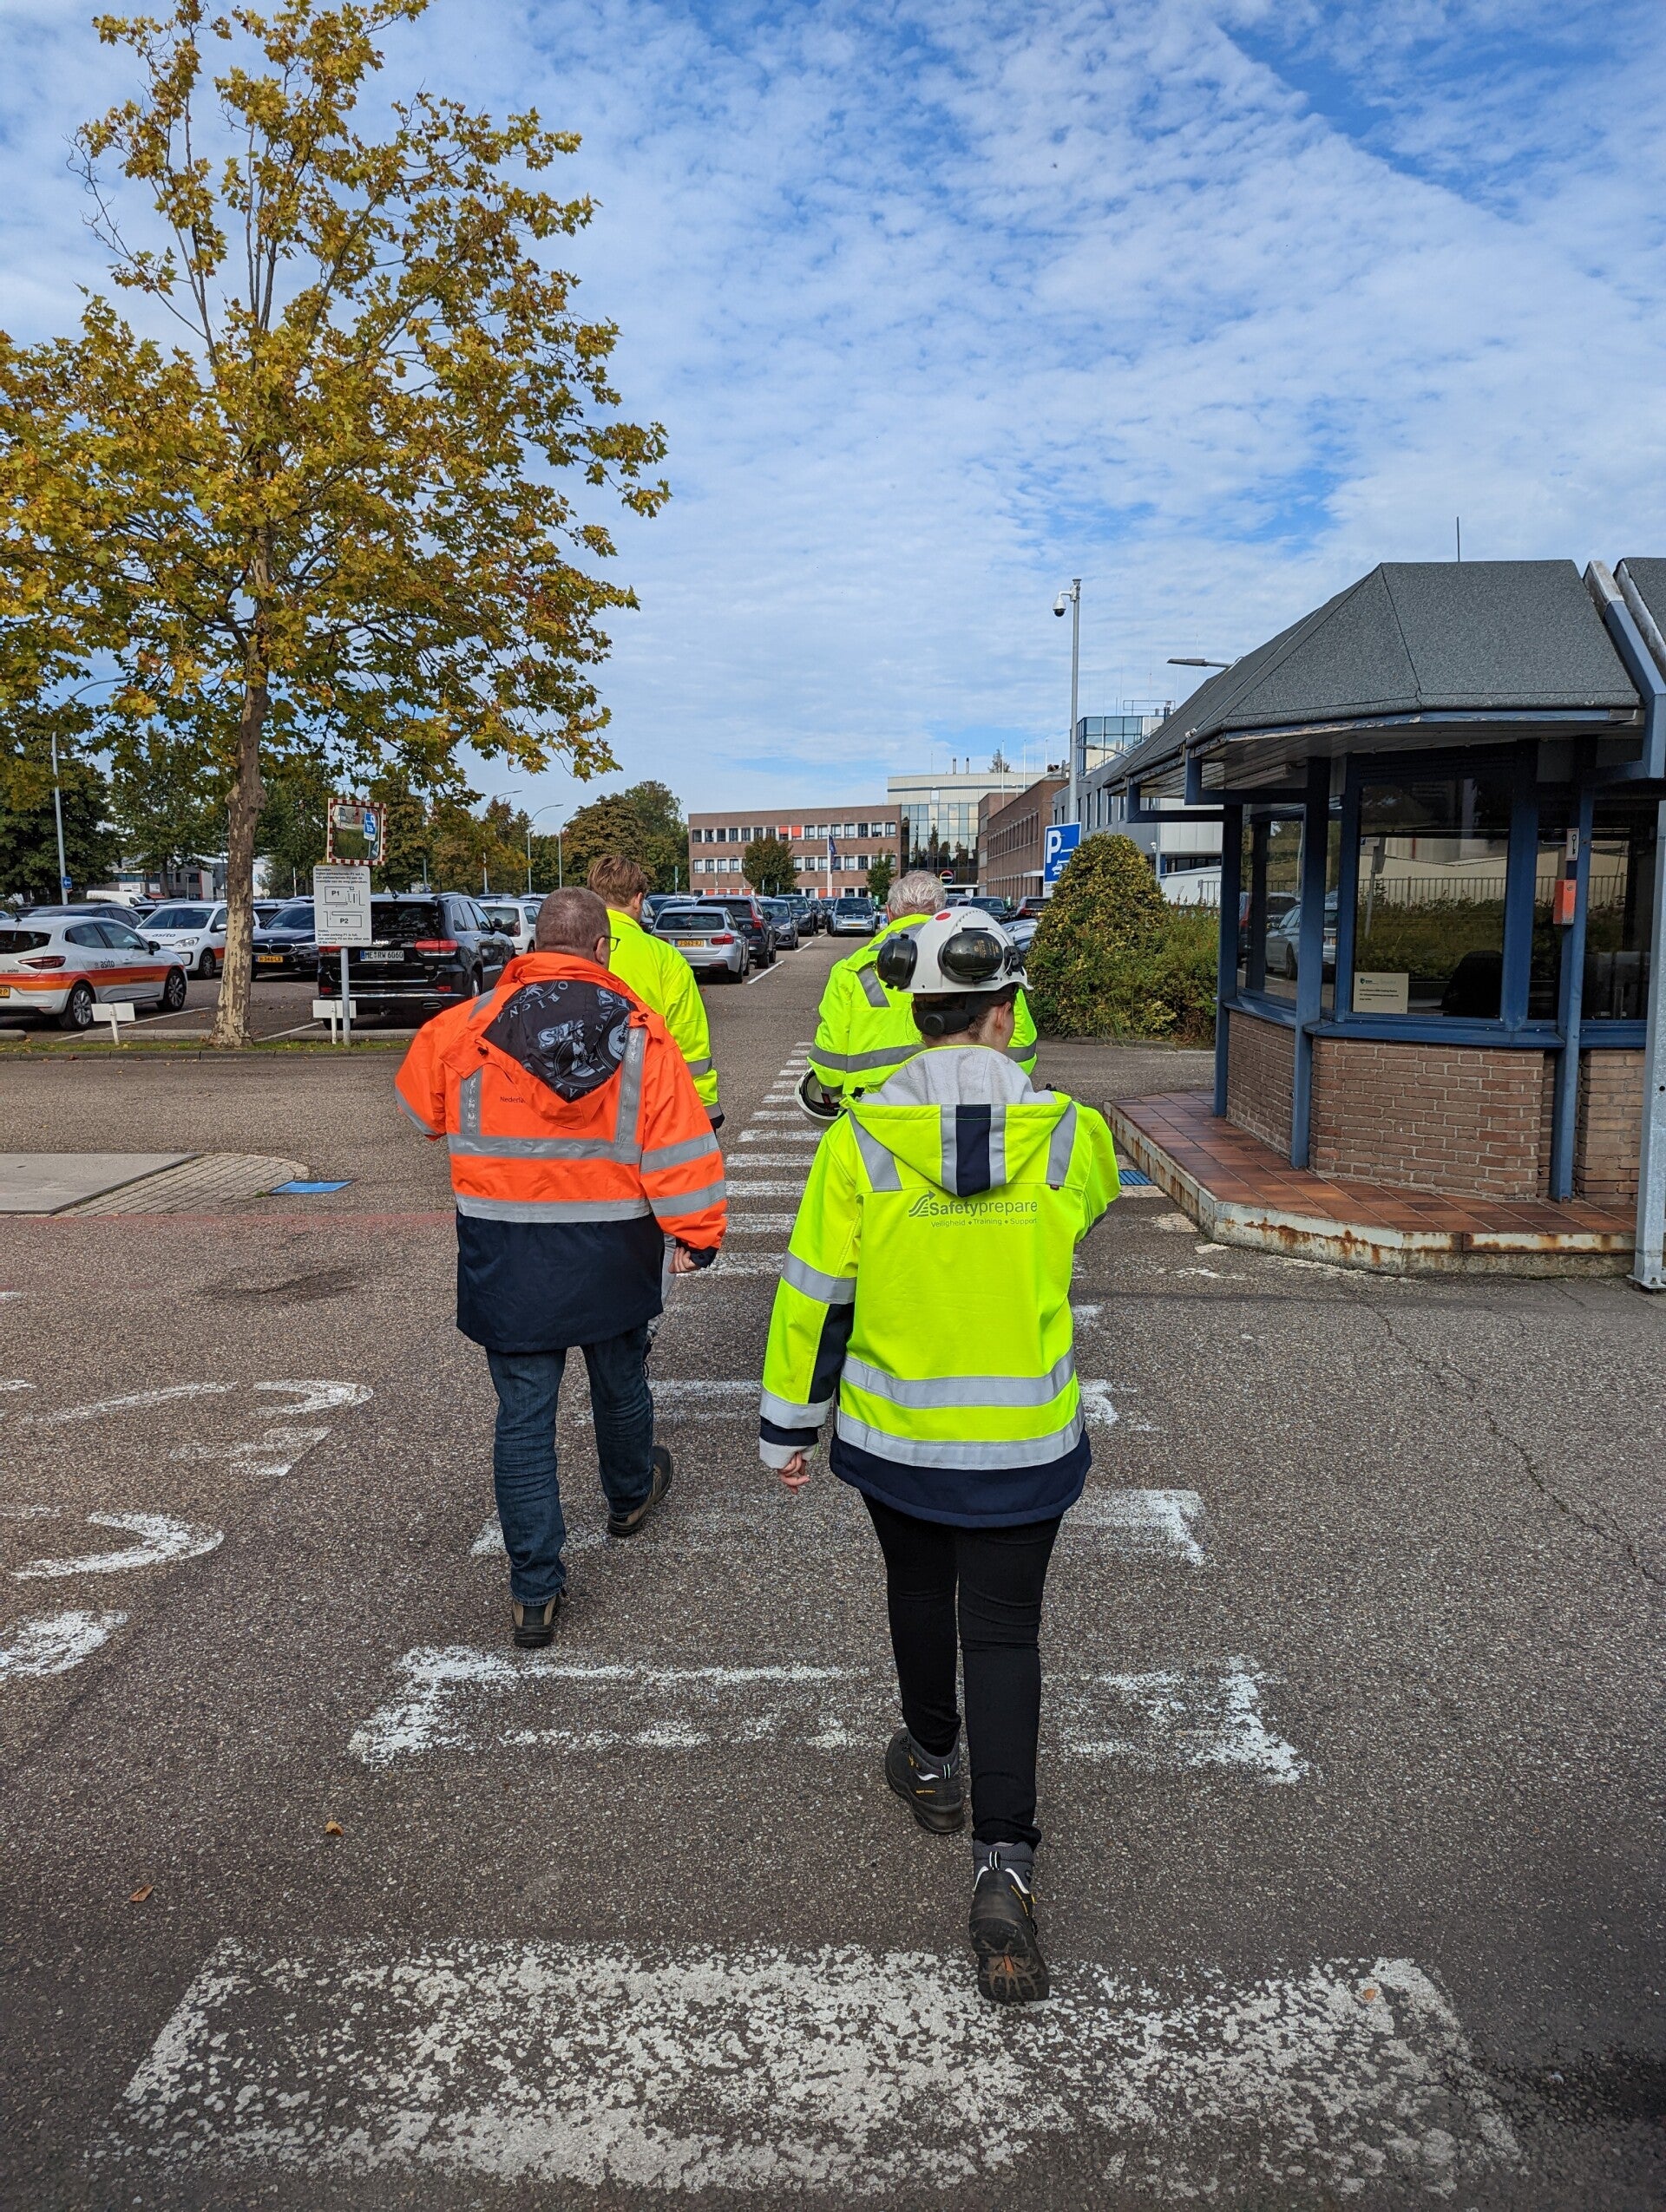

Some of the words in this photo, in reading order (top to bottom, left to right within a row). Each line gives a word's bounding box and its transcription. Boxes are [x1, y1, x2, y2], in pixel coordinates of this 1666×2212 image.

[1046, 830, 1062, 863] P
[100, 958, 115, 968] asito
[929, 1201, 1038, 1216] Safetyprepare
[931, 1219, 966, 1227] Veiligheid
[973, 1218, 1002, 1227] Training
